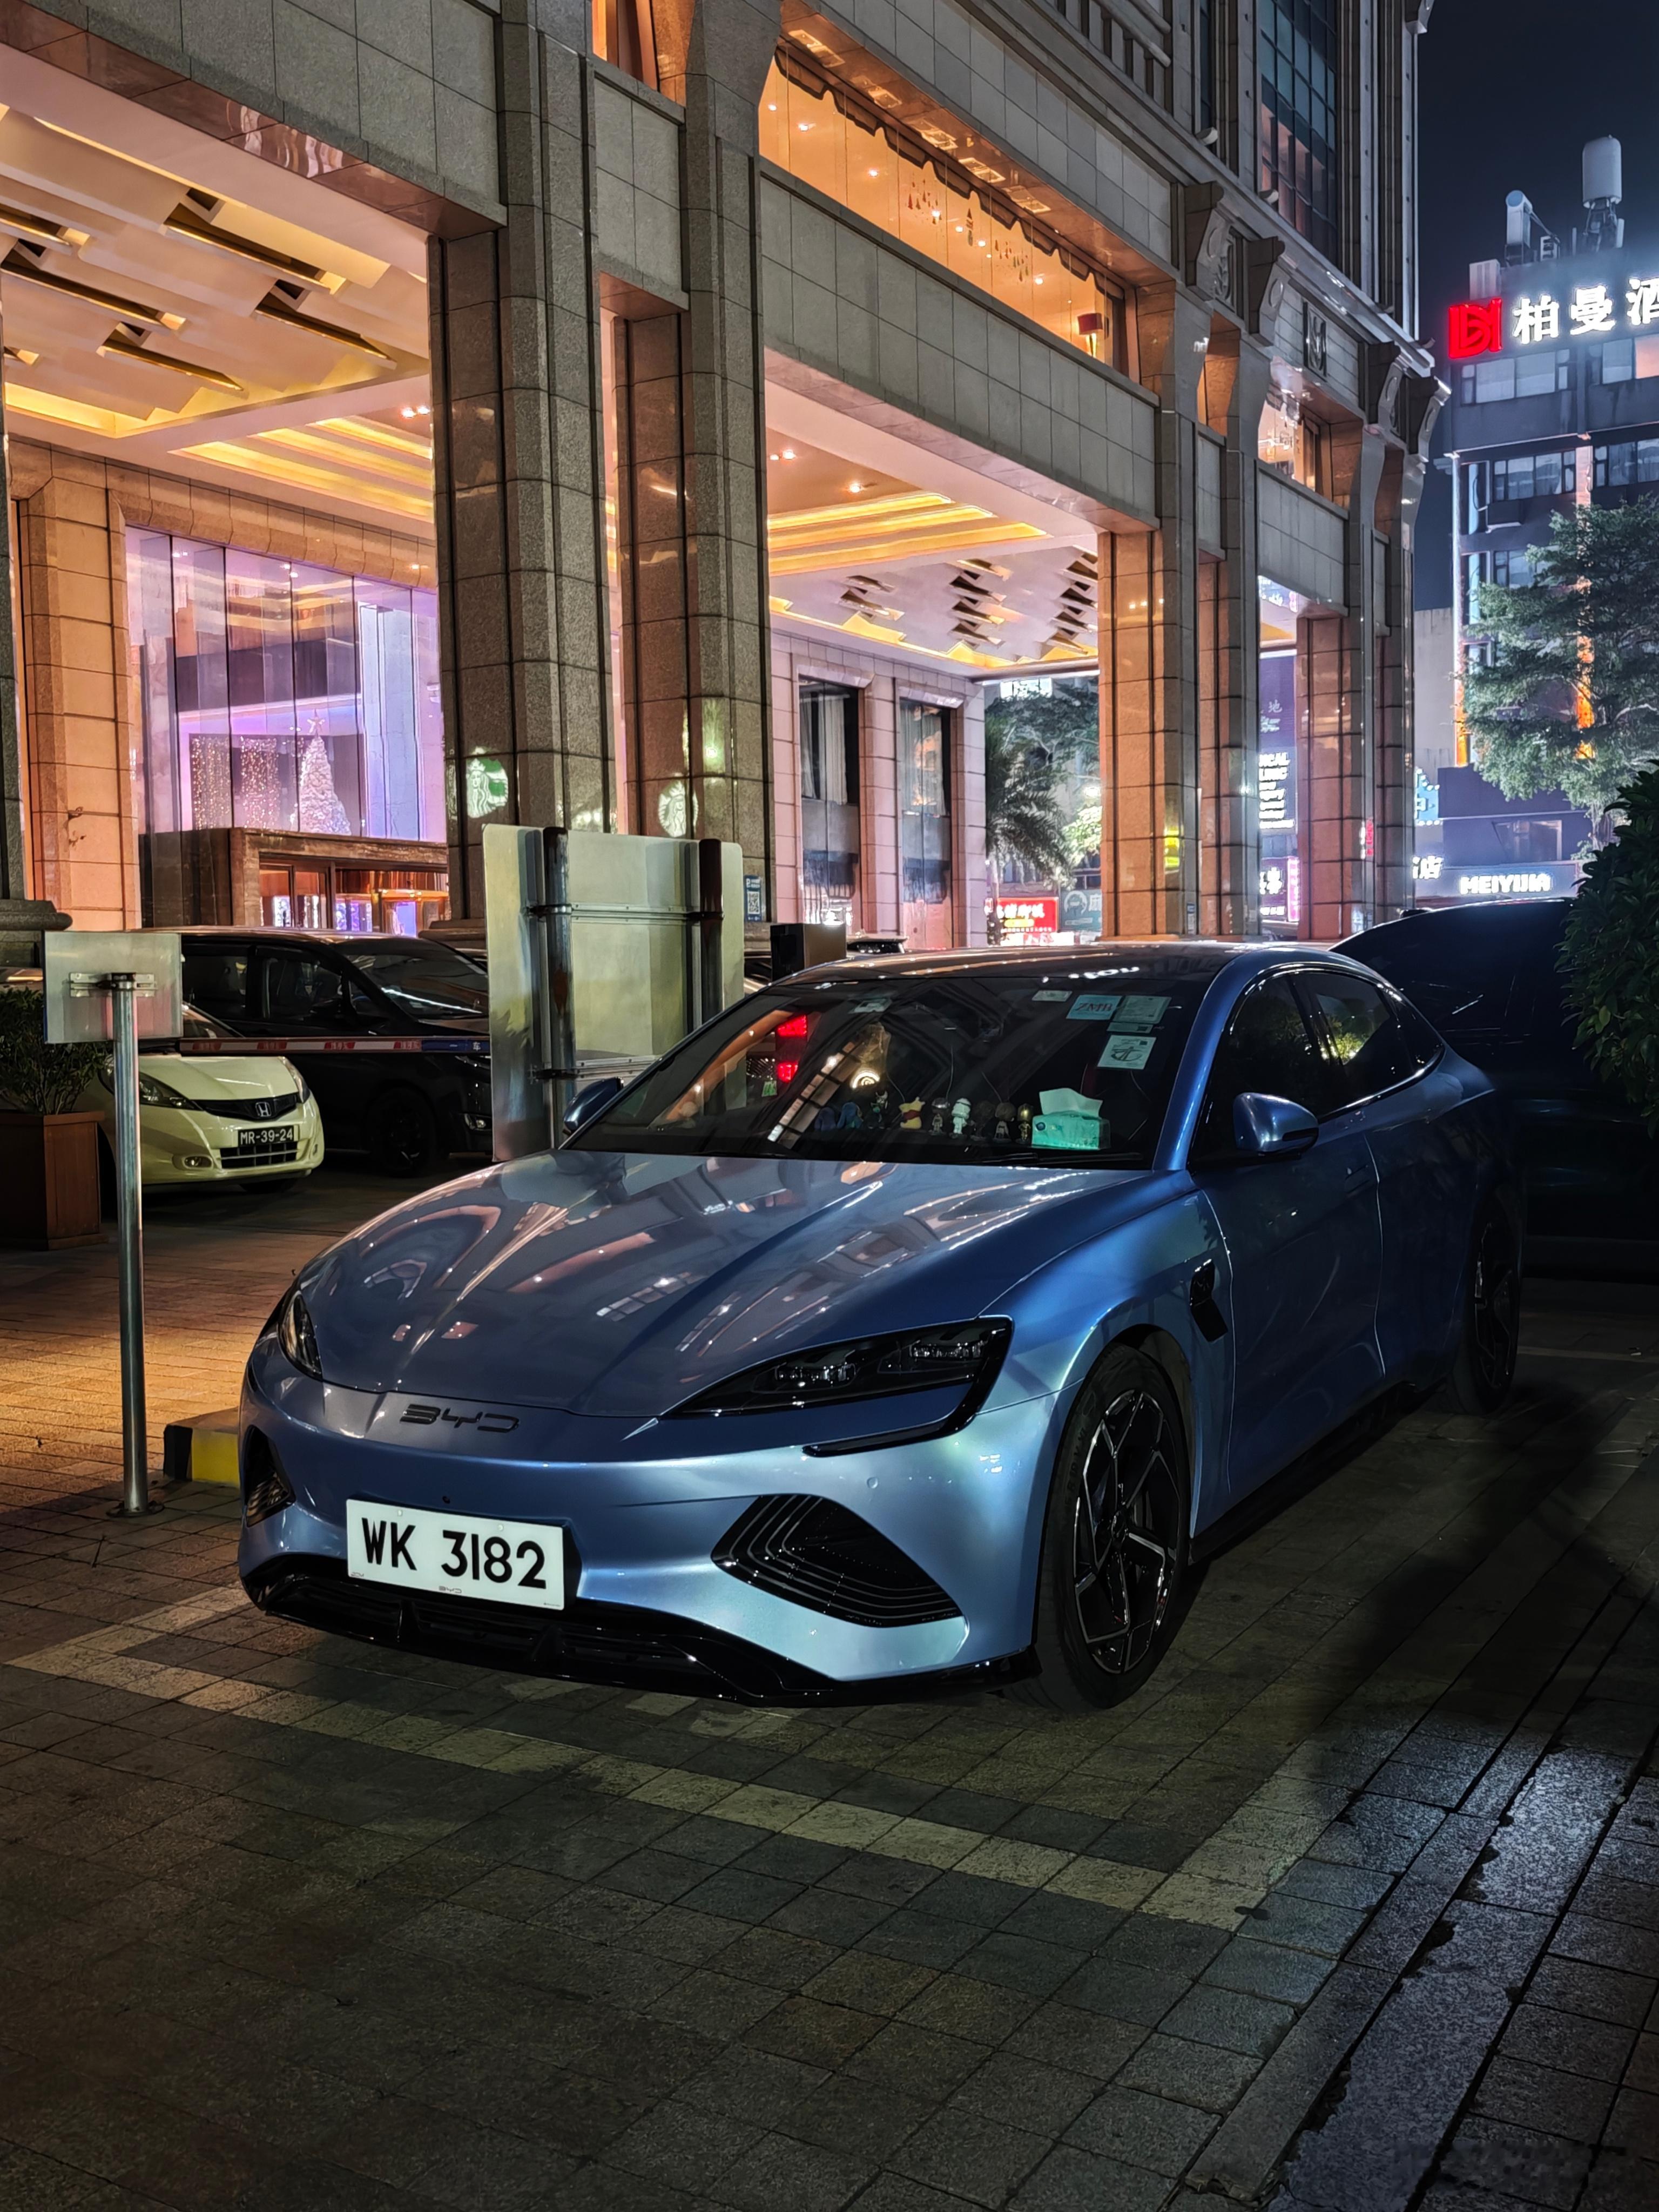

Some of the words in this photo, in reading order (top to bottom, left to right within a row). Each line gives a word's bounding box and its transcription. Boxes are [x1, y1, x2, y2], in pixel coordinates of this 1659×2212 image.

[1513, 278, 1659, 344] 柏曼酒
[240, 1128, 293, 1145] MR-39-24
[400, 1404, 520, 1434] BYD
[361, 1518, 417, 1571] WK
[441, 1529, 547, 1590] 3182
[439, 1586, 462, 1594] BYD
